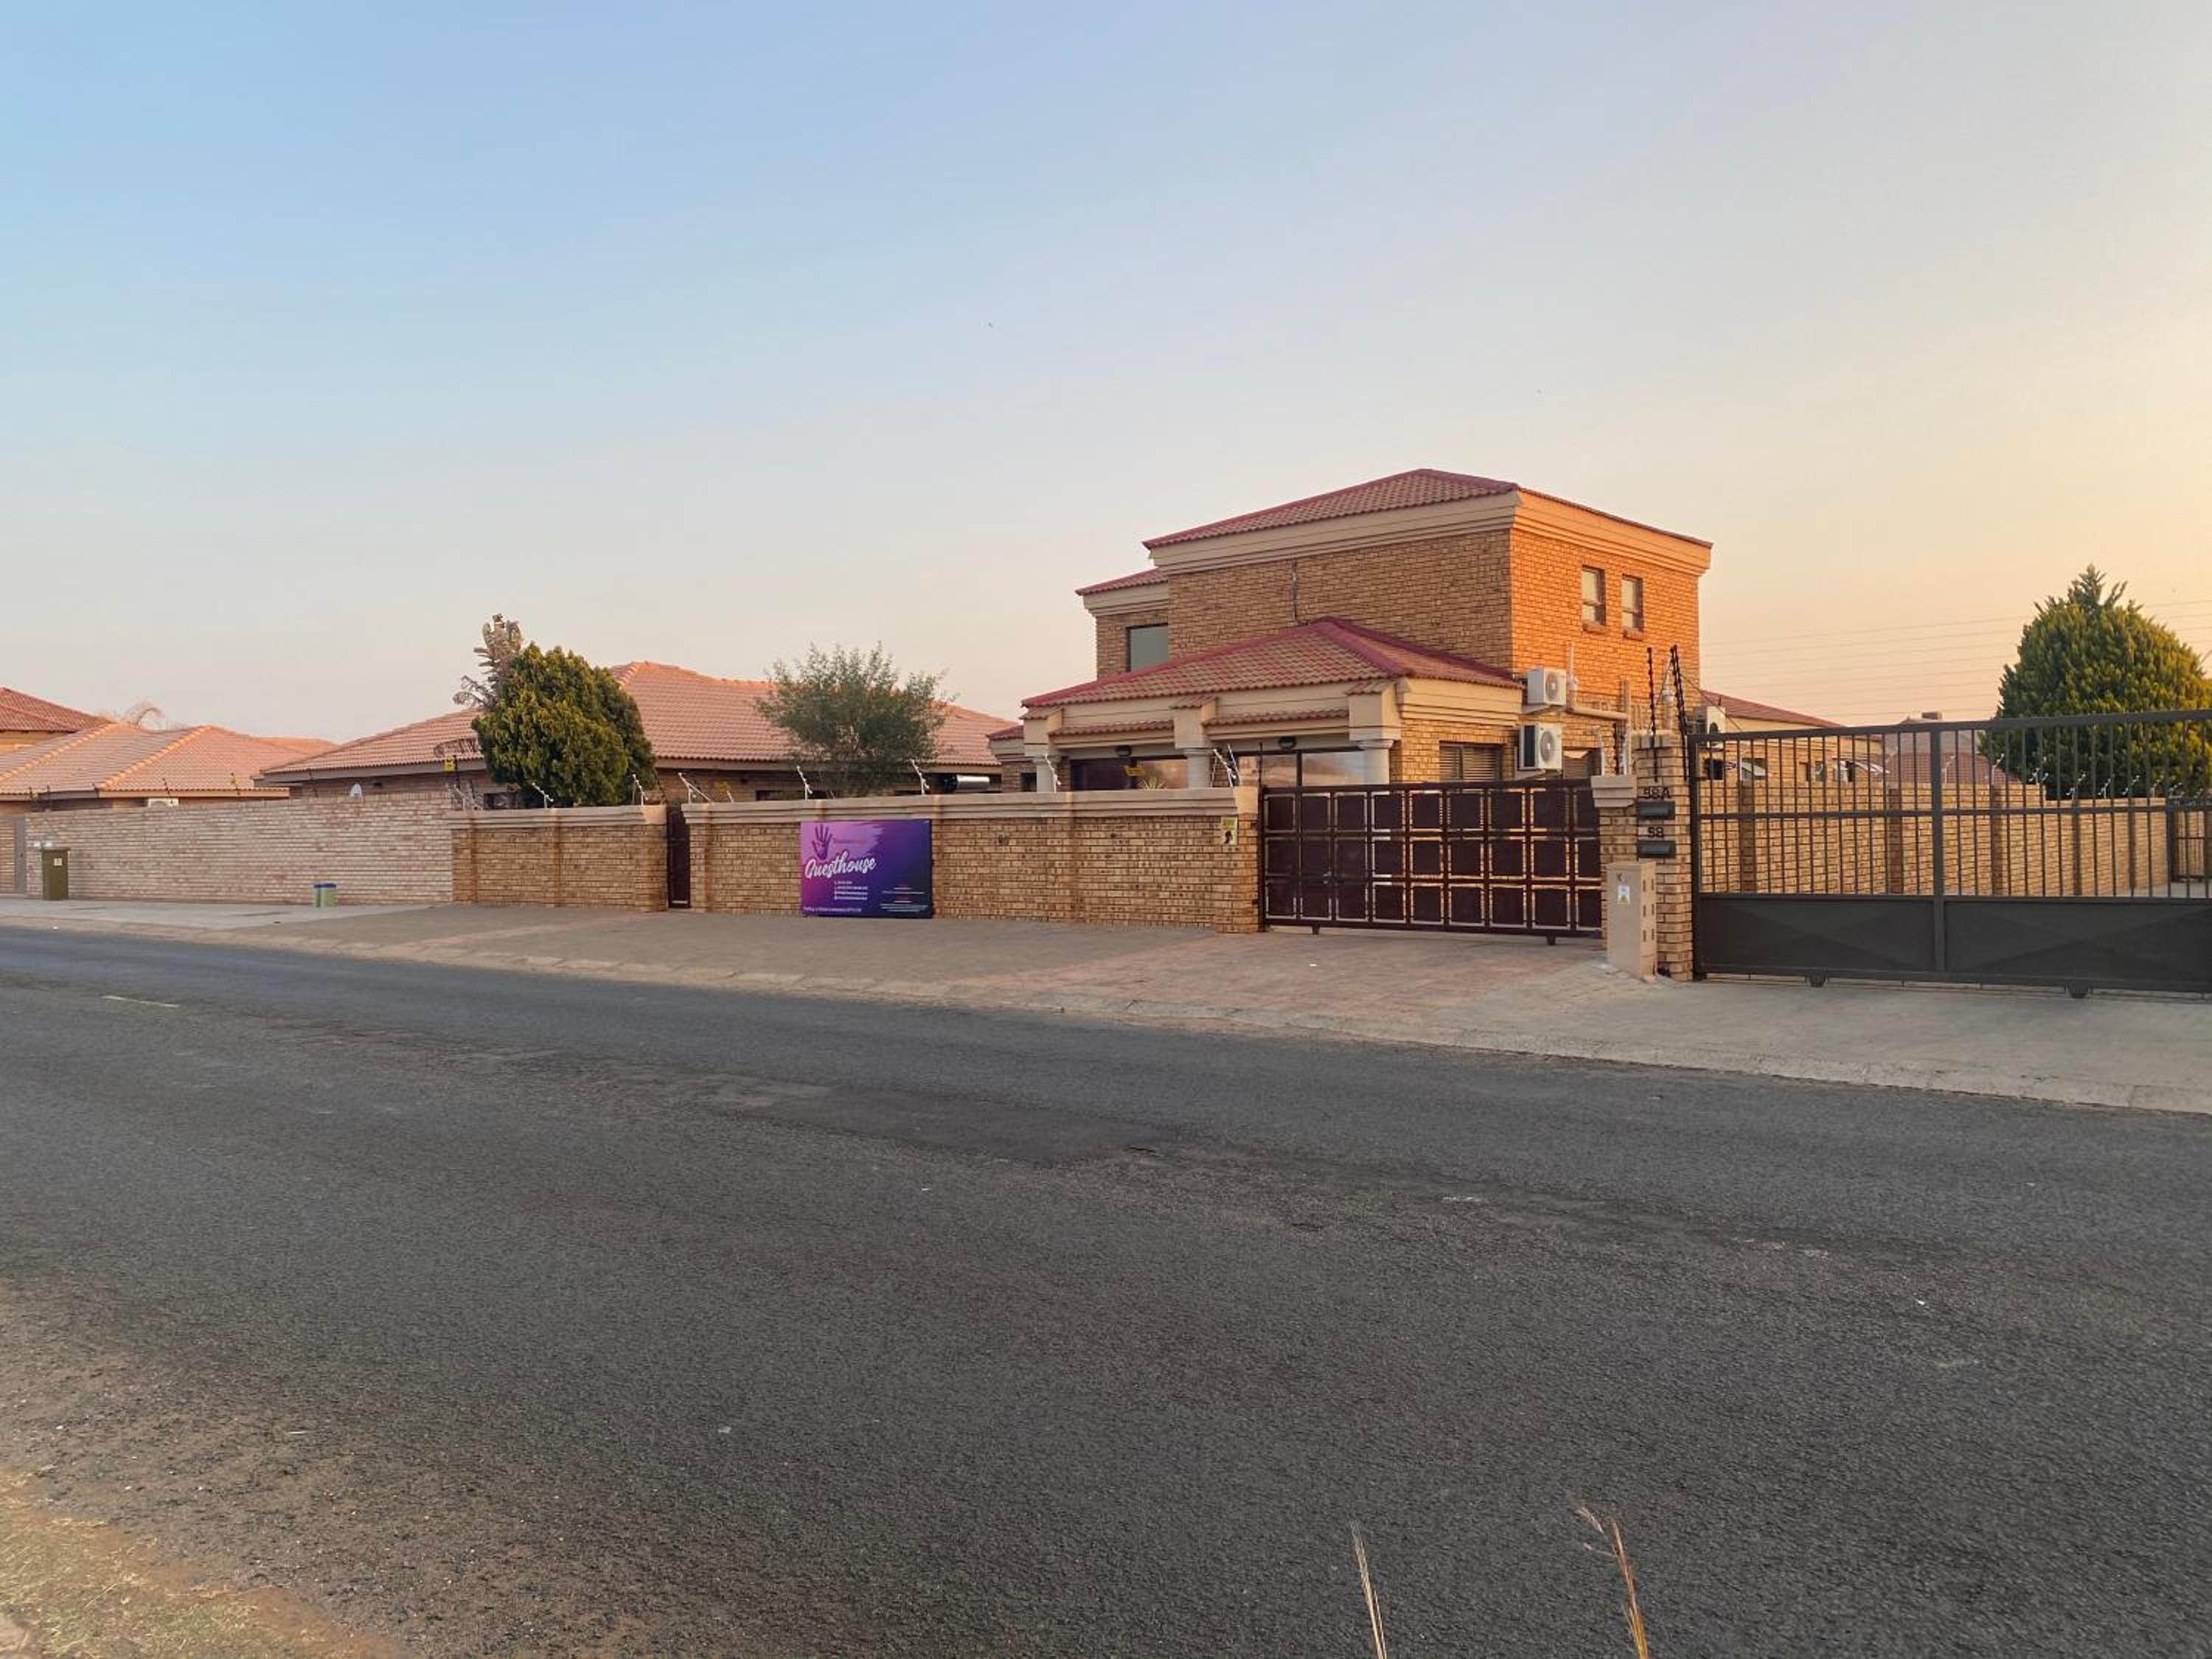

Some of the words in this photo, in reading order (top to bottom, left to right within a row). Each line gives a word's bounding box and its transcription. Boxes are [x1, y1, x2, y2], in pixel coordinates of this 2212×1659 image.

[1644, 787, 1672, 800] 58A
[1647, 826, 1664, 838] 58
[804, 849, 876, 878] Guesthouse
